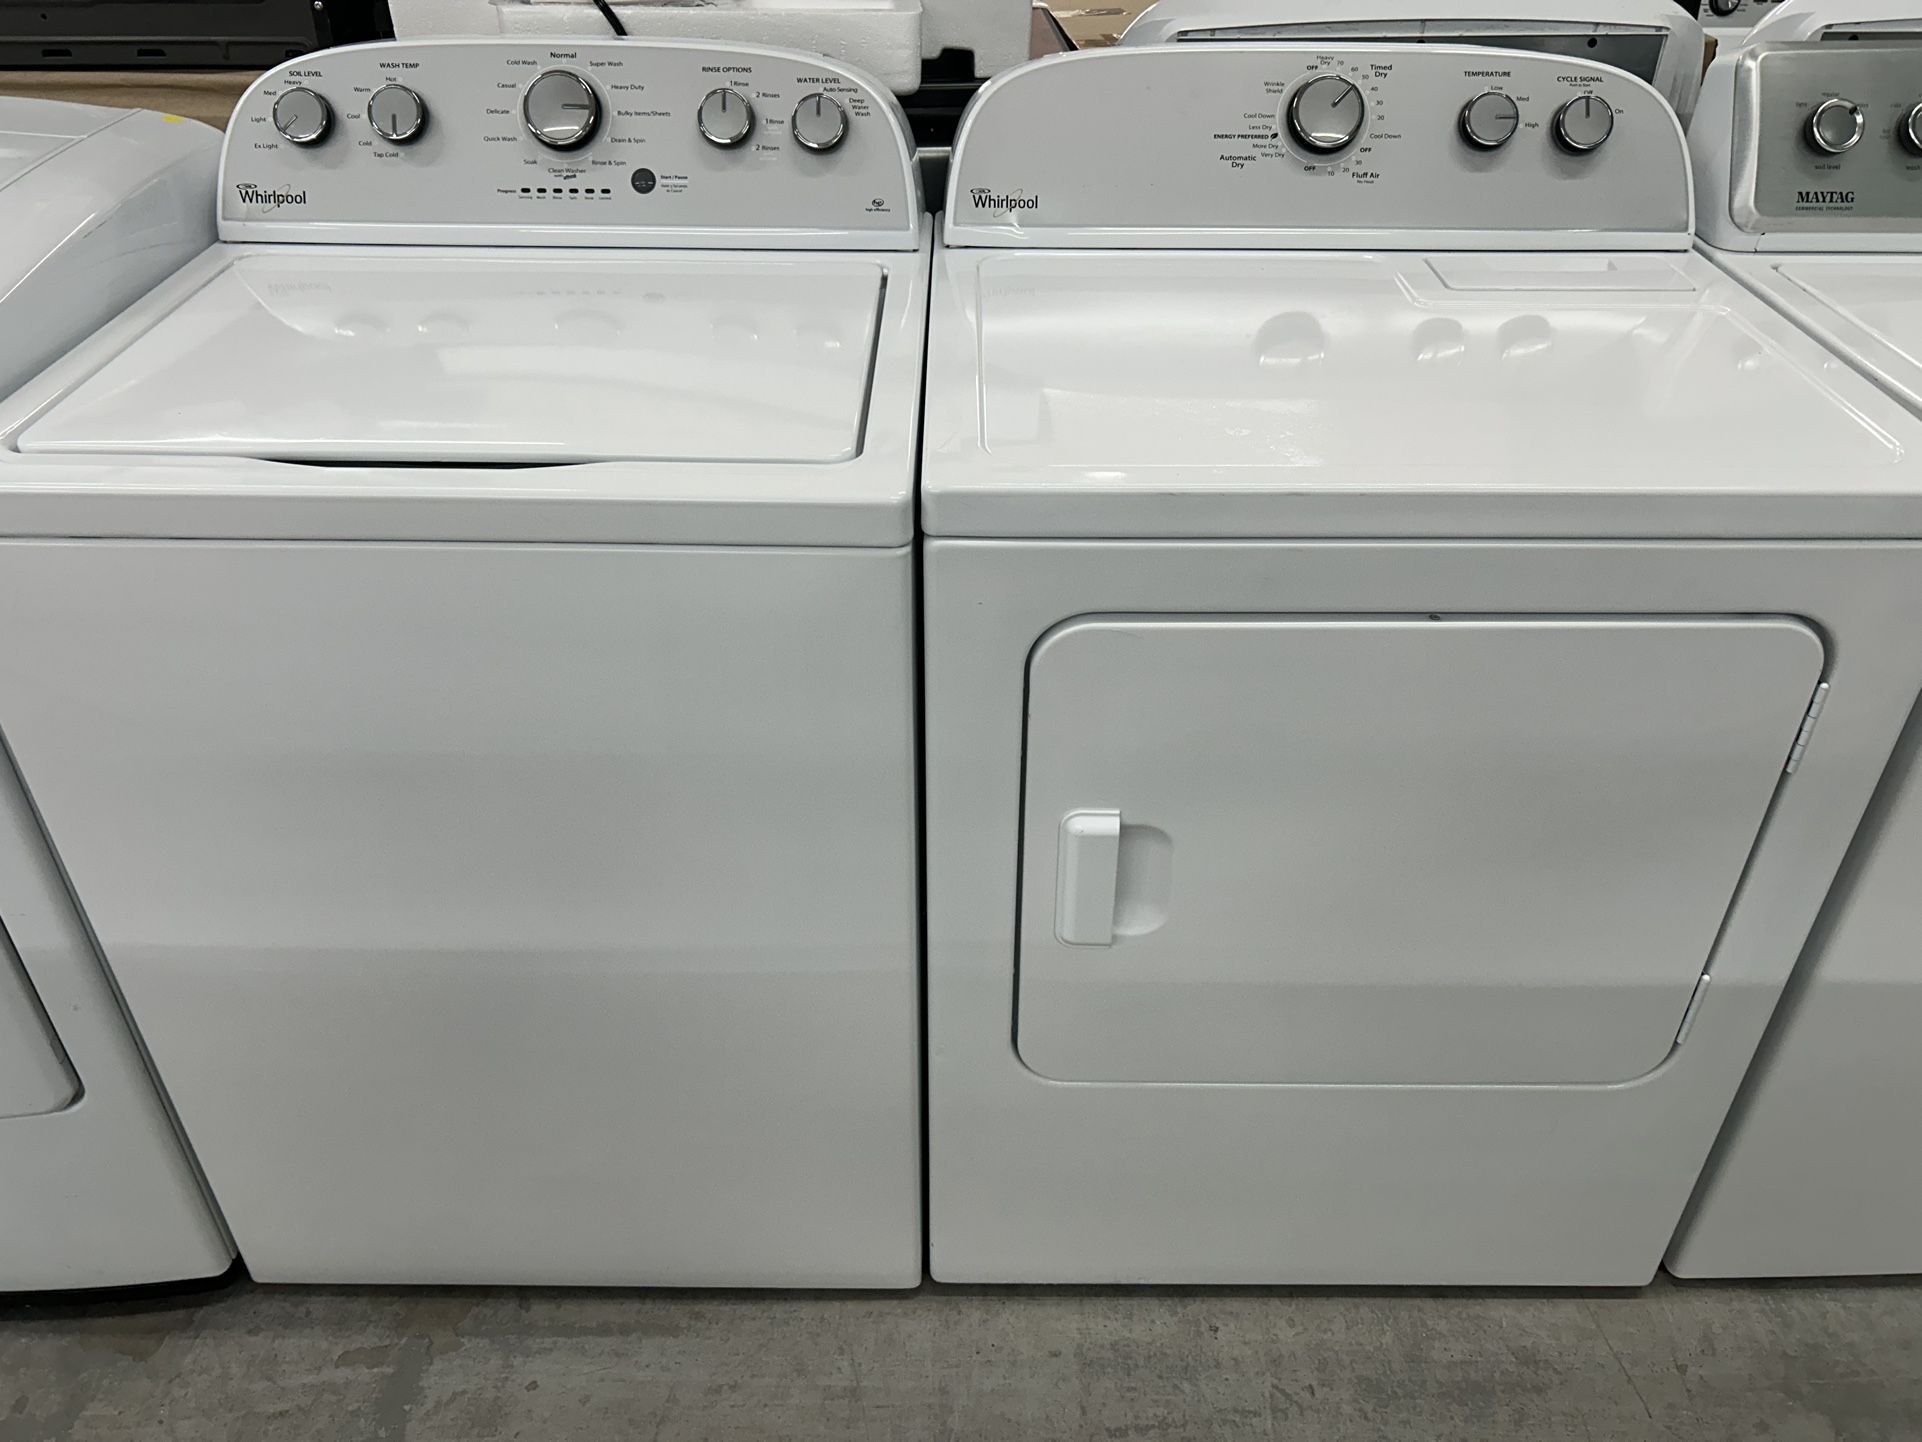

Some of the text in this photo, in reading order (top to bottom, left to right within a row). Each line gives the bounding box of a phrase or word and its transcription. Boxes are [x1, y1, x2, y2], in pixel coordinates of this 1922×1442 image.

[239, 190, 306, 208] Whirlpool
[972, 195, 1038, 212] Whirlpool
[1797, 192, 1855, 203] MAYTAG
